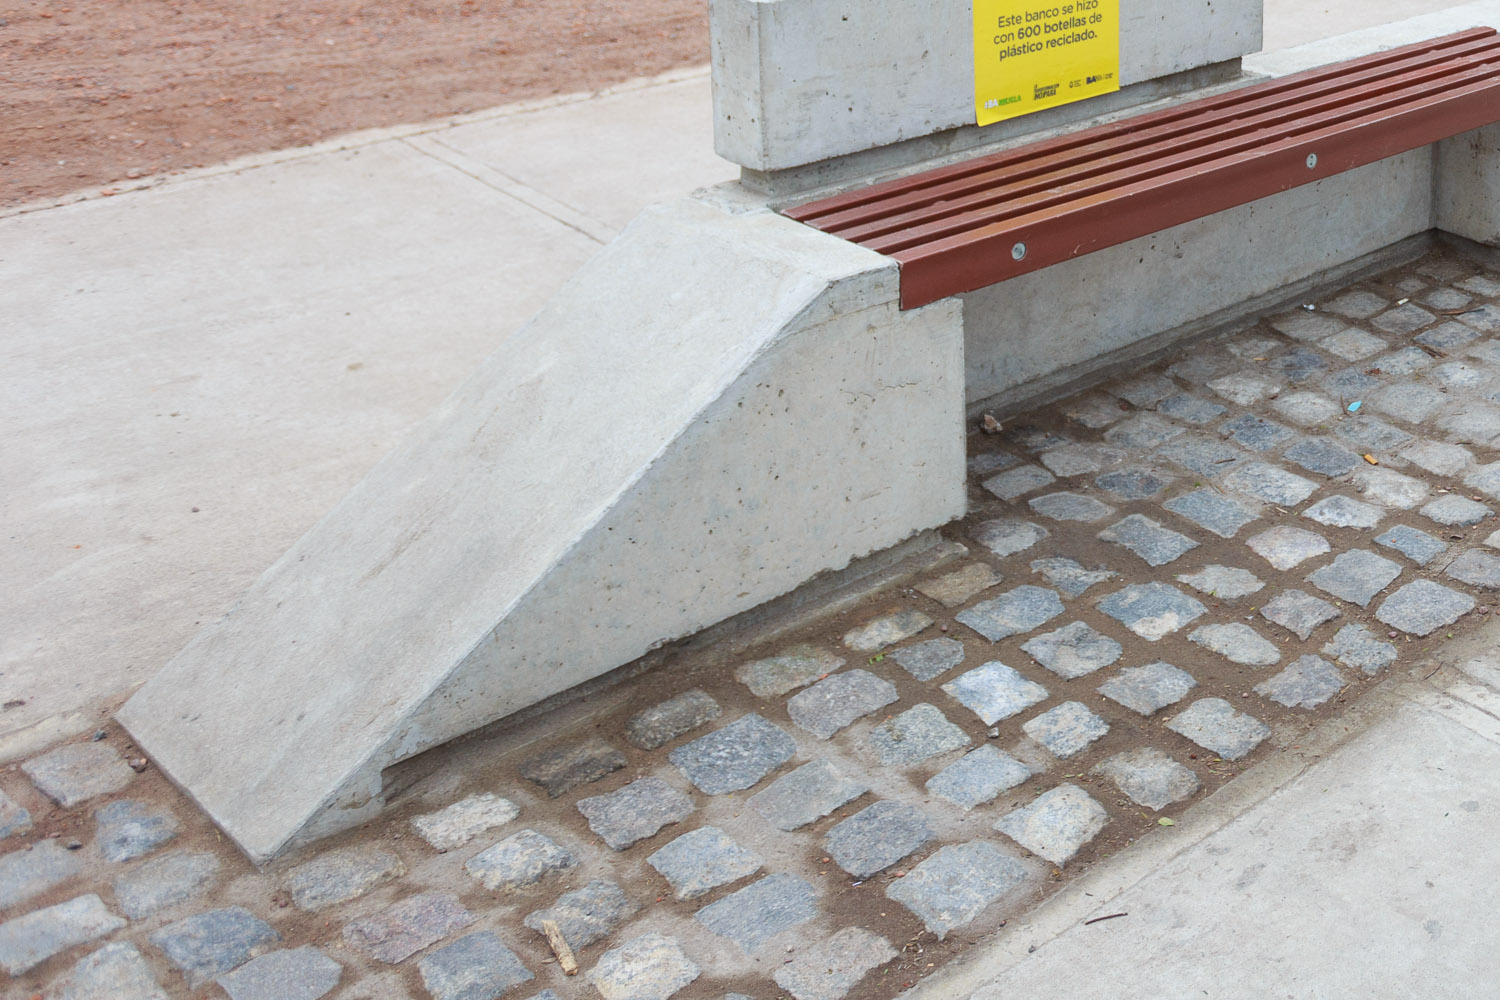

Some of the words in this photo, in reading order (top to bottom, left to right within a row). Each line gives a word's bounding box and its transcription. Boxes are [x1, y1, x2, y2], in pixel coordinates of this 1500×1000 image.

[993, 32, 1015, 45] con
[1017, 24, 1041, 40] 600
[1044, 16, 1087, 34] botellas
[1088, 11, 1103, 25] de
[998, 14, 1023, 29] Este
[1025, 10, 1060, 23] banco
[1061, 4, 1074, 15] se
[1076, 0, 1099, 12] hizo
[999, 41, 1043, 62] plástico
[1046, 28, 1098, 49] reciclado.
